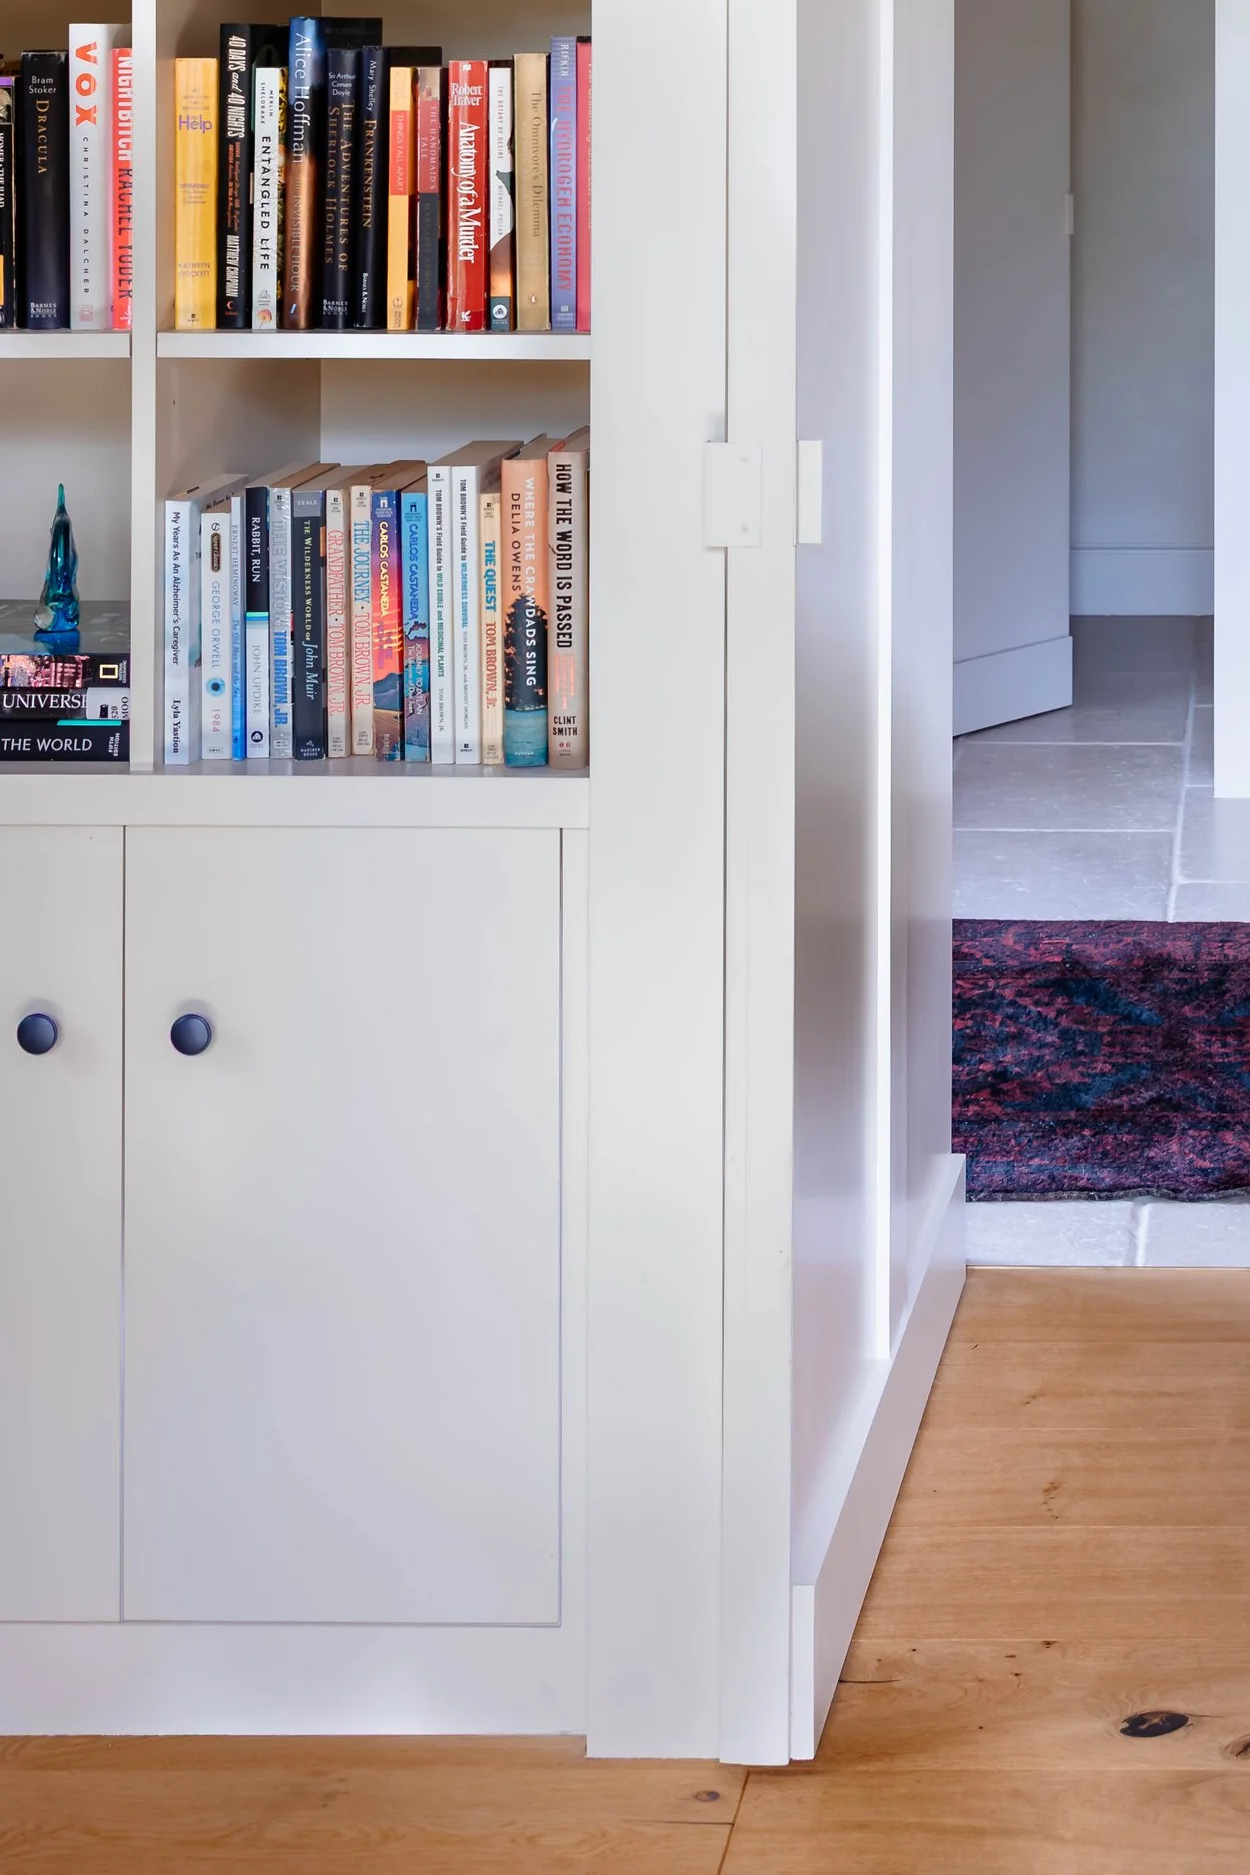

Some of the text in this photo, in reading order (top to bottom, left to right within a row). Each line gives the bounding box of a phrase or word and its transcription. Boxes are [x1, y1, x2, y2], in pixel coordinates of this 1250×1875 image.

[28, 85, 57, 94] Stoker
[31, 76, 54, 84] Bram
[75, 42, 98, 126] VOX
[228, 46, 246, 138] DAYS and NIGHTS
[293, 32, 312, 164] Alice Hoffman
[451, 83, 482, 97] Robert
[452, 95, 481, 106] Traver
[35, 100, 50, 174] DRACULA
[178, 115, 213, 134] Help
[362, 119, 377, 228] FRANKENSTEIN
[451, 122, 480, 179] Anatomy
[260, 136, 271, 270] ENTANGLED LIFE
[458, 213, 481, 264] Murder
[556, 463, 572, 494] HOW
[556, 498, 572, 526] THE
[251, 517, 260, 582] RABBIT, RUN
[512, 493, 521, 592] DELIA OWENS
[556, 530, 572, 571] WORD
[524, 478, 537, 687] WHERE THE CRAWDADS SING
[556, 576, 572, 591] IS
[211, 581, 220, 669] GEORGE ORWELL
[556, 595, 572, 649] PASSED
[173, 699, 181, 722] Lyla
[552, 725, 578, 737] SMITH
[553, 715, 576, 725] CLINT
[1, 738, 92, 751] THE WORLD
